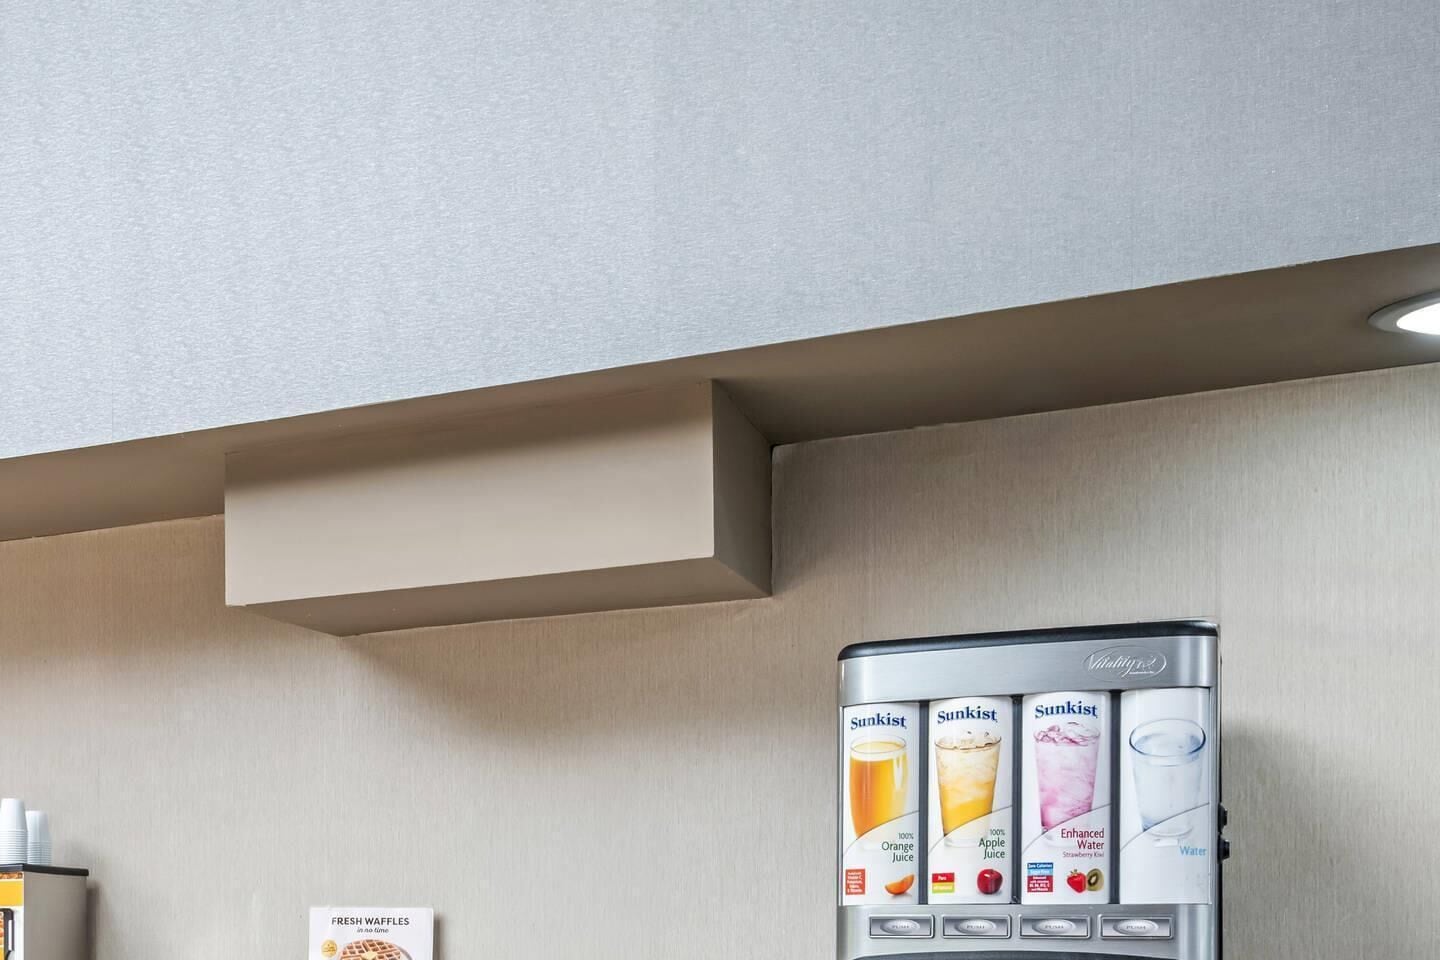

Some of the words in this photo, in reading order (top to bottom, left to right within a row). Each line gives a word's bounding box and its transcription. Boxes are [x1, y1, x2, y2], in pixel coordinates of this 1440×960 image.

[937, 705, 998, 724] Sunkist
[1035, 701, 1098, 719] Sunkist
[850, 712, 908, 730] Sunkist
[898, 832, 914, 840] 100%
[989, 828, 1006, 836] 100%
[1061, 827, 1104, 838] Enhanced
[881, 841, 914, 853] Orange
[978, 837, 1006, 851] Apple
[1077, 840, 1104, 850] Water
[984, 849, 1006, 859] Juice
[1063, 851, 1093, 859] Strawberry
[1179, 845, 1207, 856] Water
[892, 852, 914, 863] Juice
[331, 917, 363, 926] FRESH
[364, 917, 410, 926] WAFFLES
[357, 926, 363, 934] in
[374, 926, 389, 934] time
